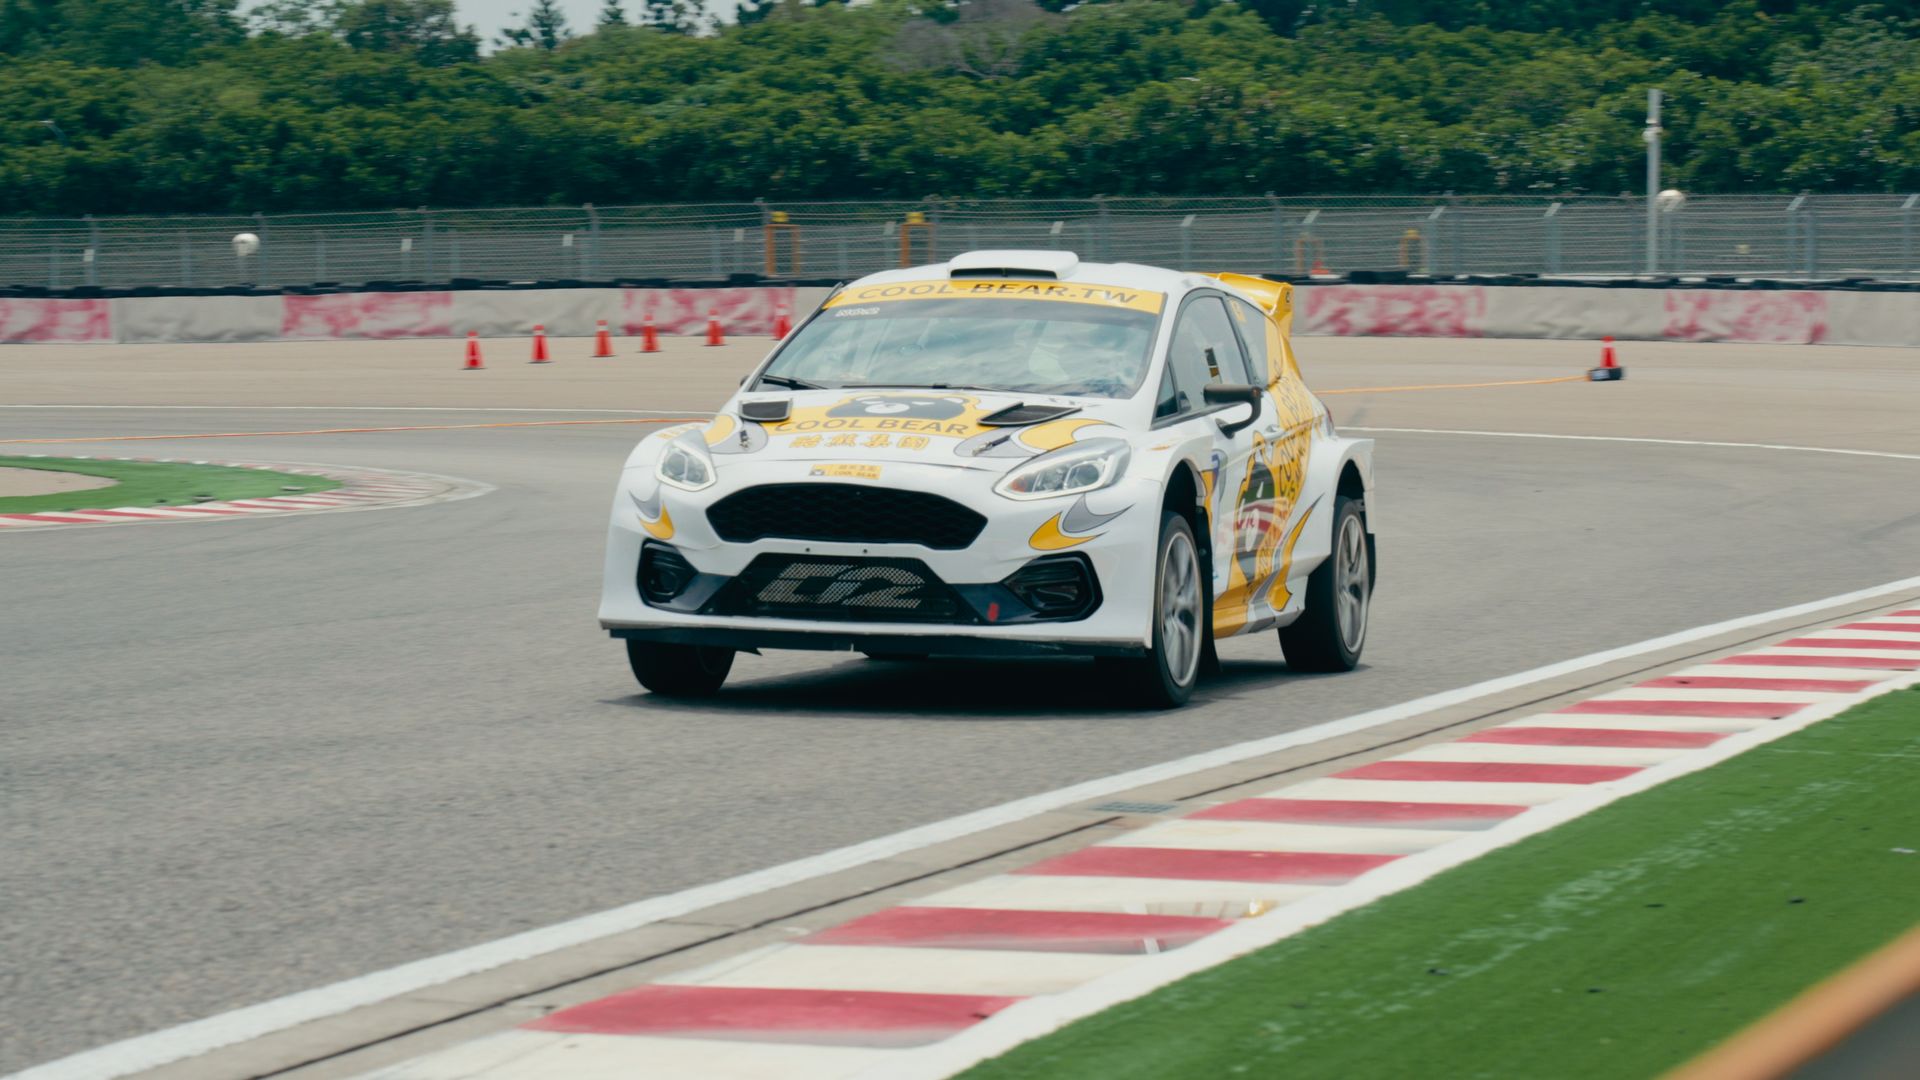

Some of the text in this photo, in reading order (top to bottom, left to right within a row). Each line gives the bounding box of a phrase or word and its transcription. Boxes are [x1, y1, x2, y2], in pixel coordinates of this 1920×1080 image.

[857, 282, 1139, 304] COOL-BEAR.TW
[774, 418, 969, 435] COOL BEAR
